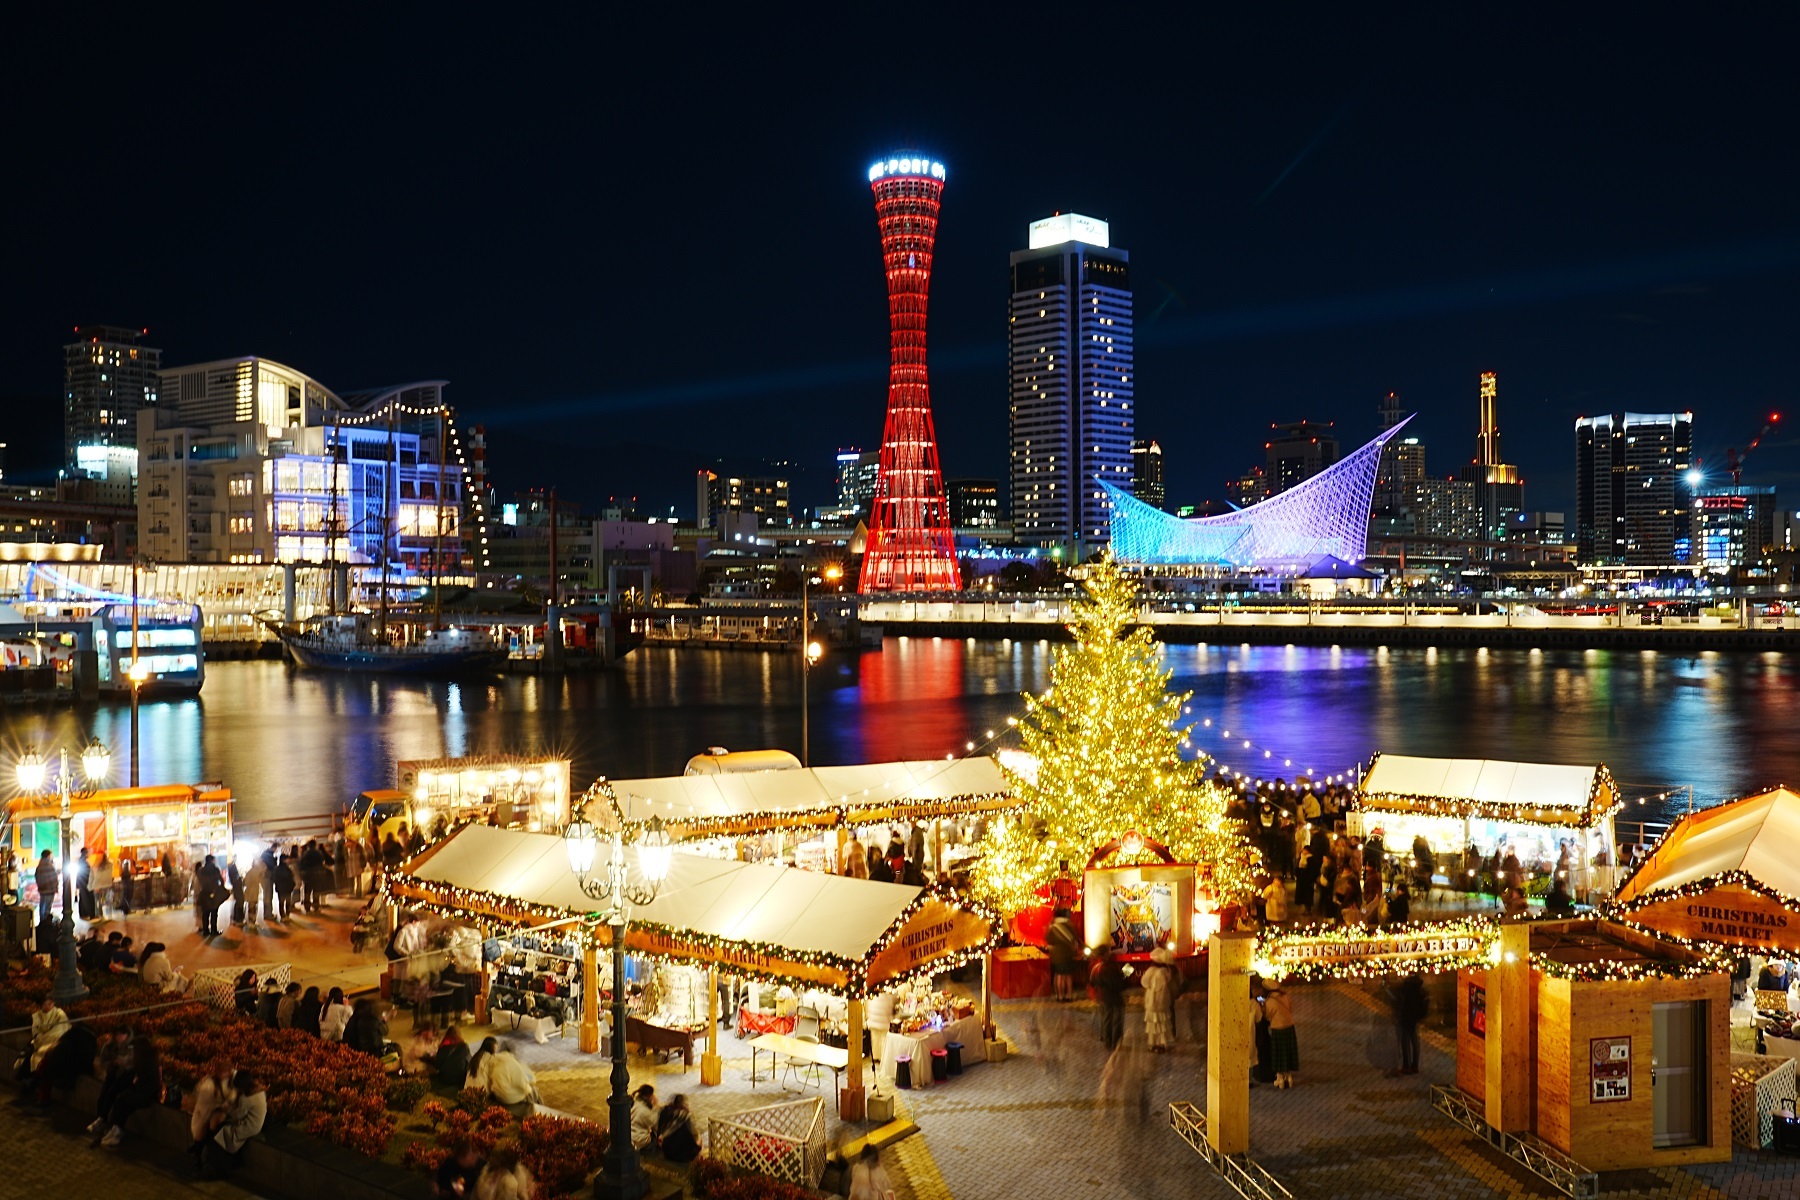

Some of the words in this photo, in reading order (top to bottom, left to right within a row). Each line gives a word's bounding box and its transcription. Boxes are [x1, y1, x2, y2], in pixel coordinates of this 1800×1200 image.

[889, 159, 930, 175] PORT
[1687, 904, 1788, 928] CHRISTMAS
[902, 919, 954, 949] CHRISTMAS
[1701, 921, 1774, 941] MARKET
[910, 938, 948, 962] MARKET
[1273, 941, 1391, 961] CHRISTMAS
[1397, 937, 1478, 954] MARKET
